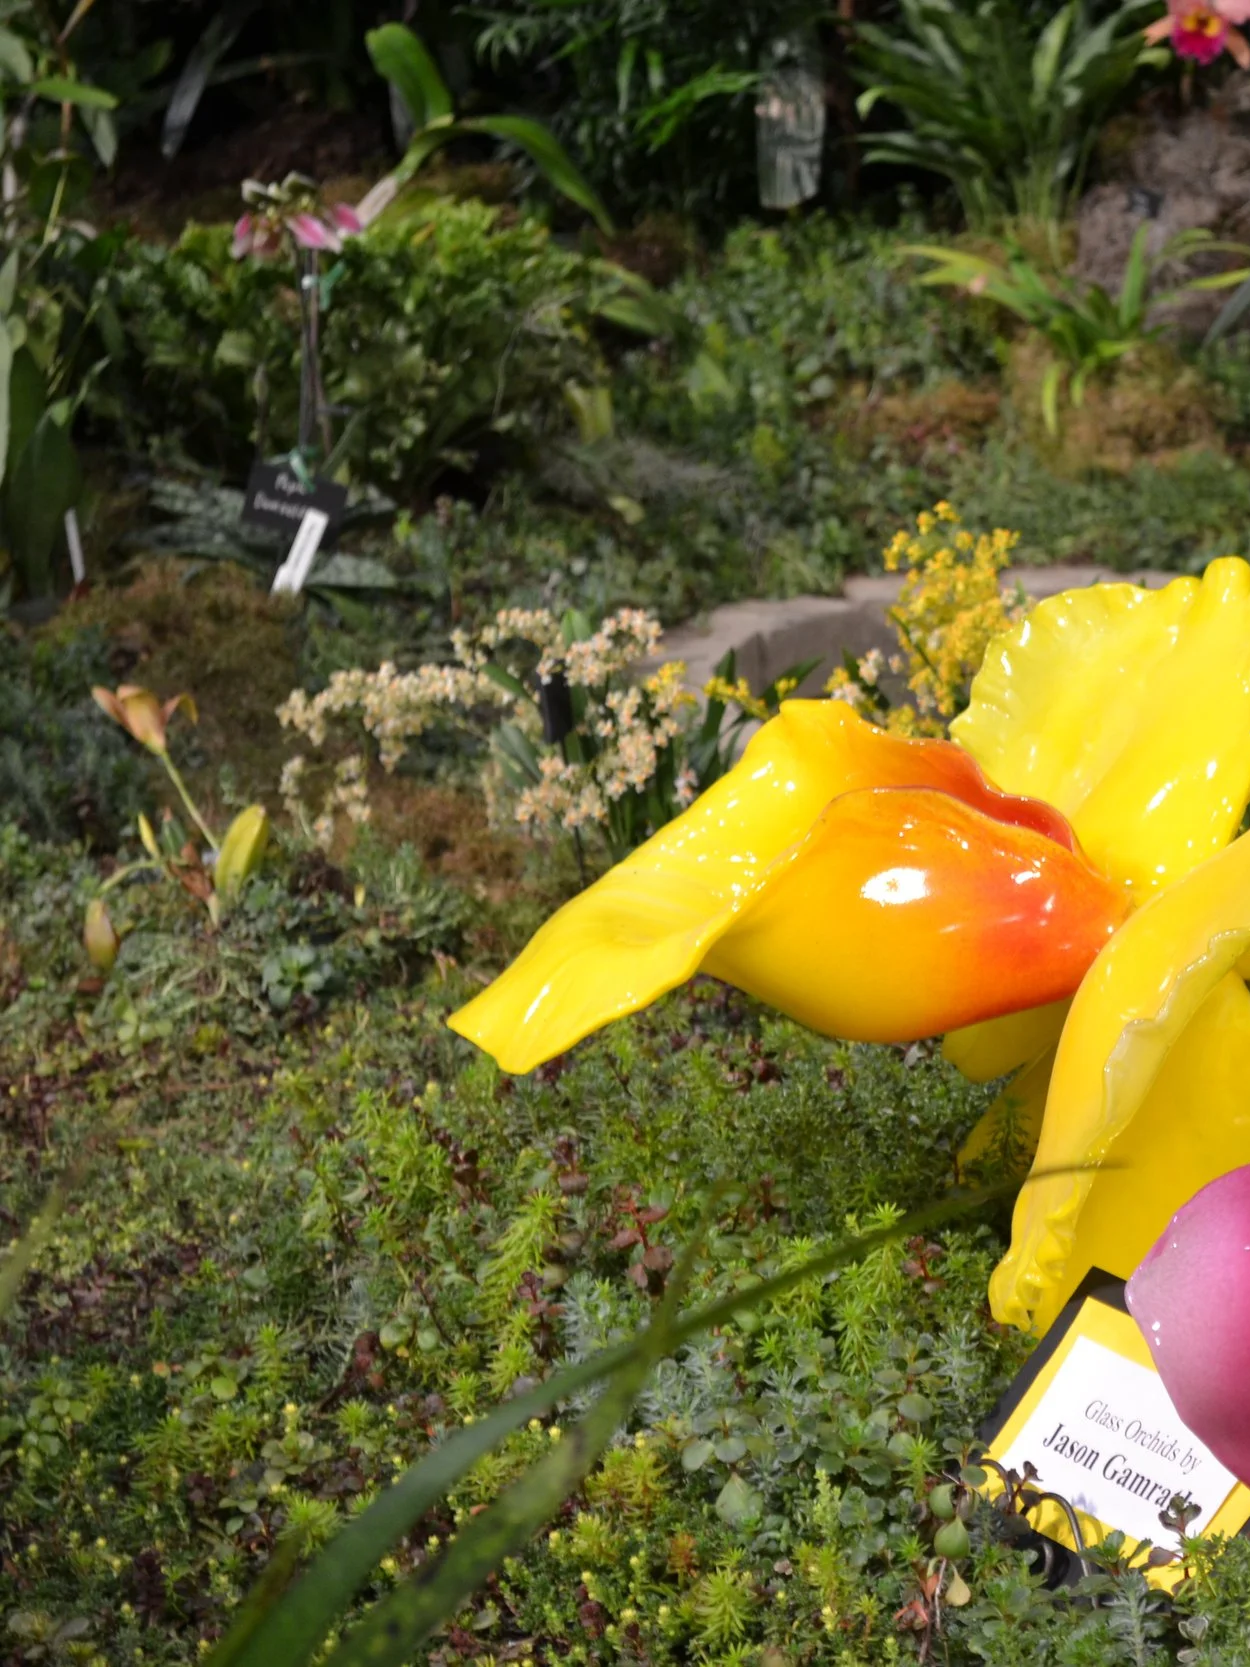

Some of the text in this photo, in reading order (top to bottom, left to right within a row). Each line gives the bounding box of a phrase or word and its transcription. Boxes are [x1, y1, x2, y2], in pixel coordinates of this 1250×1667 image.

[1042, 1423, 1101, 1472] Jason
[1084, 1399, 1202, 1475] Glass Orchids by
